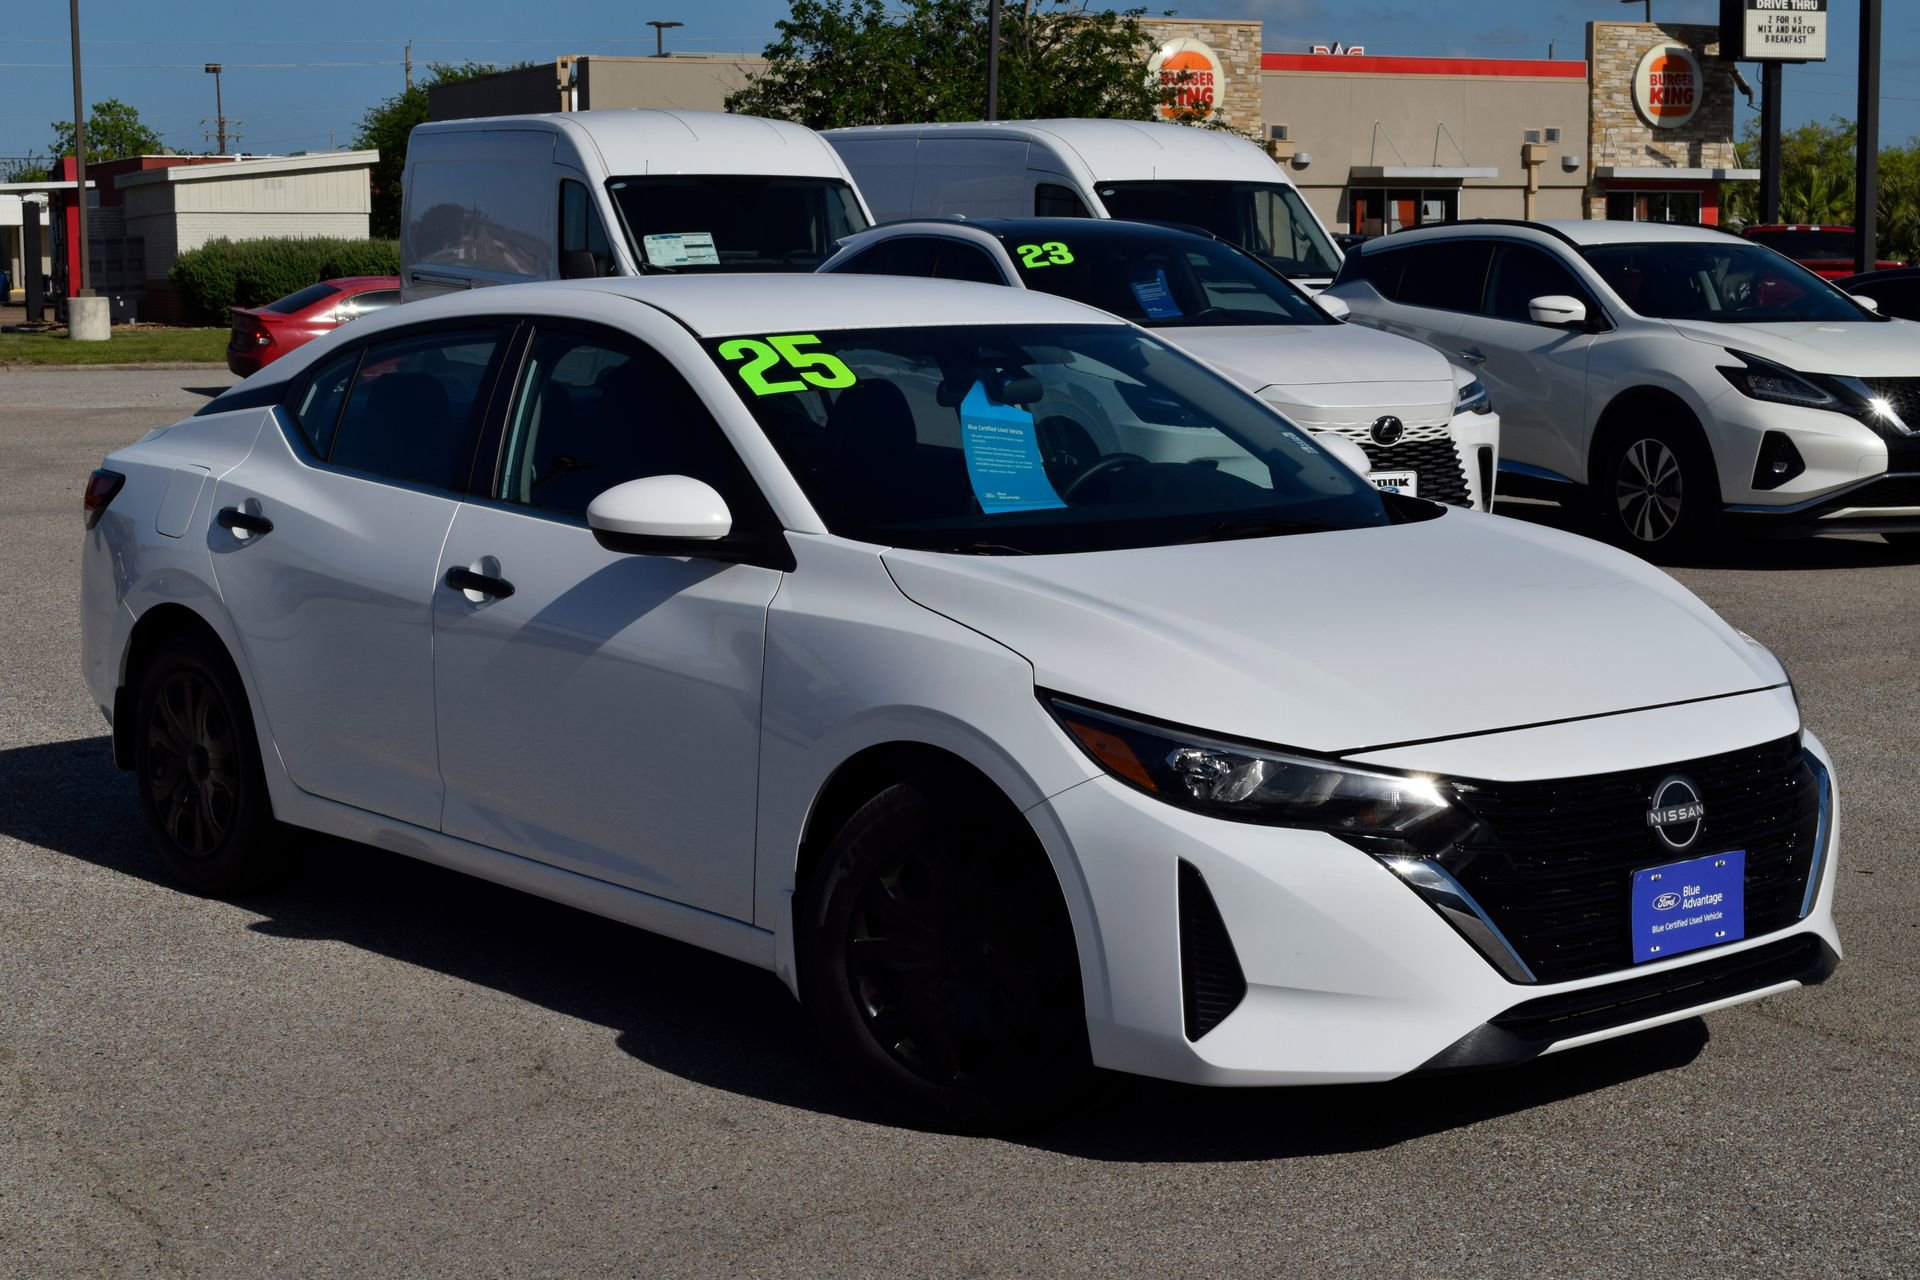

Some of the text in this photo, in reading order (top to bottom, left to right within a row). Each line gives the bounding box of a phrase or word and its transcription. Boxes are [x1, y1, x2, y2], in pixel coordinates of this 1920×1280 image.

[1756, 0, 1818, 10] DRIVE THRU
[1776, 16, 1790, 24] FOR
[1758, 25, 1816, 35] MIX AND MATCH
[1765, 34, 1807, 44] BREAKFAST
[1649, 73, 1694, 87] BURGER
[1649, 86, 1695, 105] KING
[1016, 241, 1074, 269] 23
[718, 334, 857, 396] 25
[1650, 803, 1704, 824] NISSAN
[1683, 885, 1701, 897] Blue
[1657, 895, 1677, 908] Ford
[1682, 893, 1723, 910] Advantage
[1652, 911, 1723, 934] Blue Certified Used Vehicle
